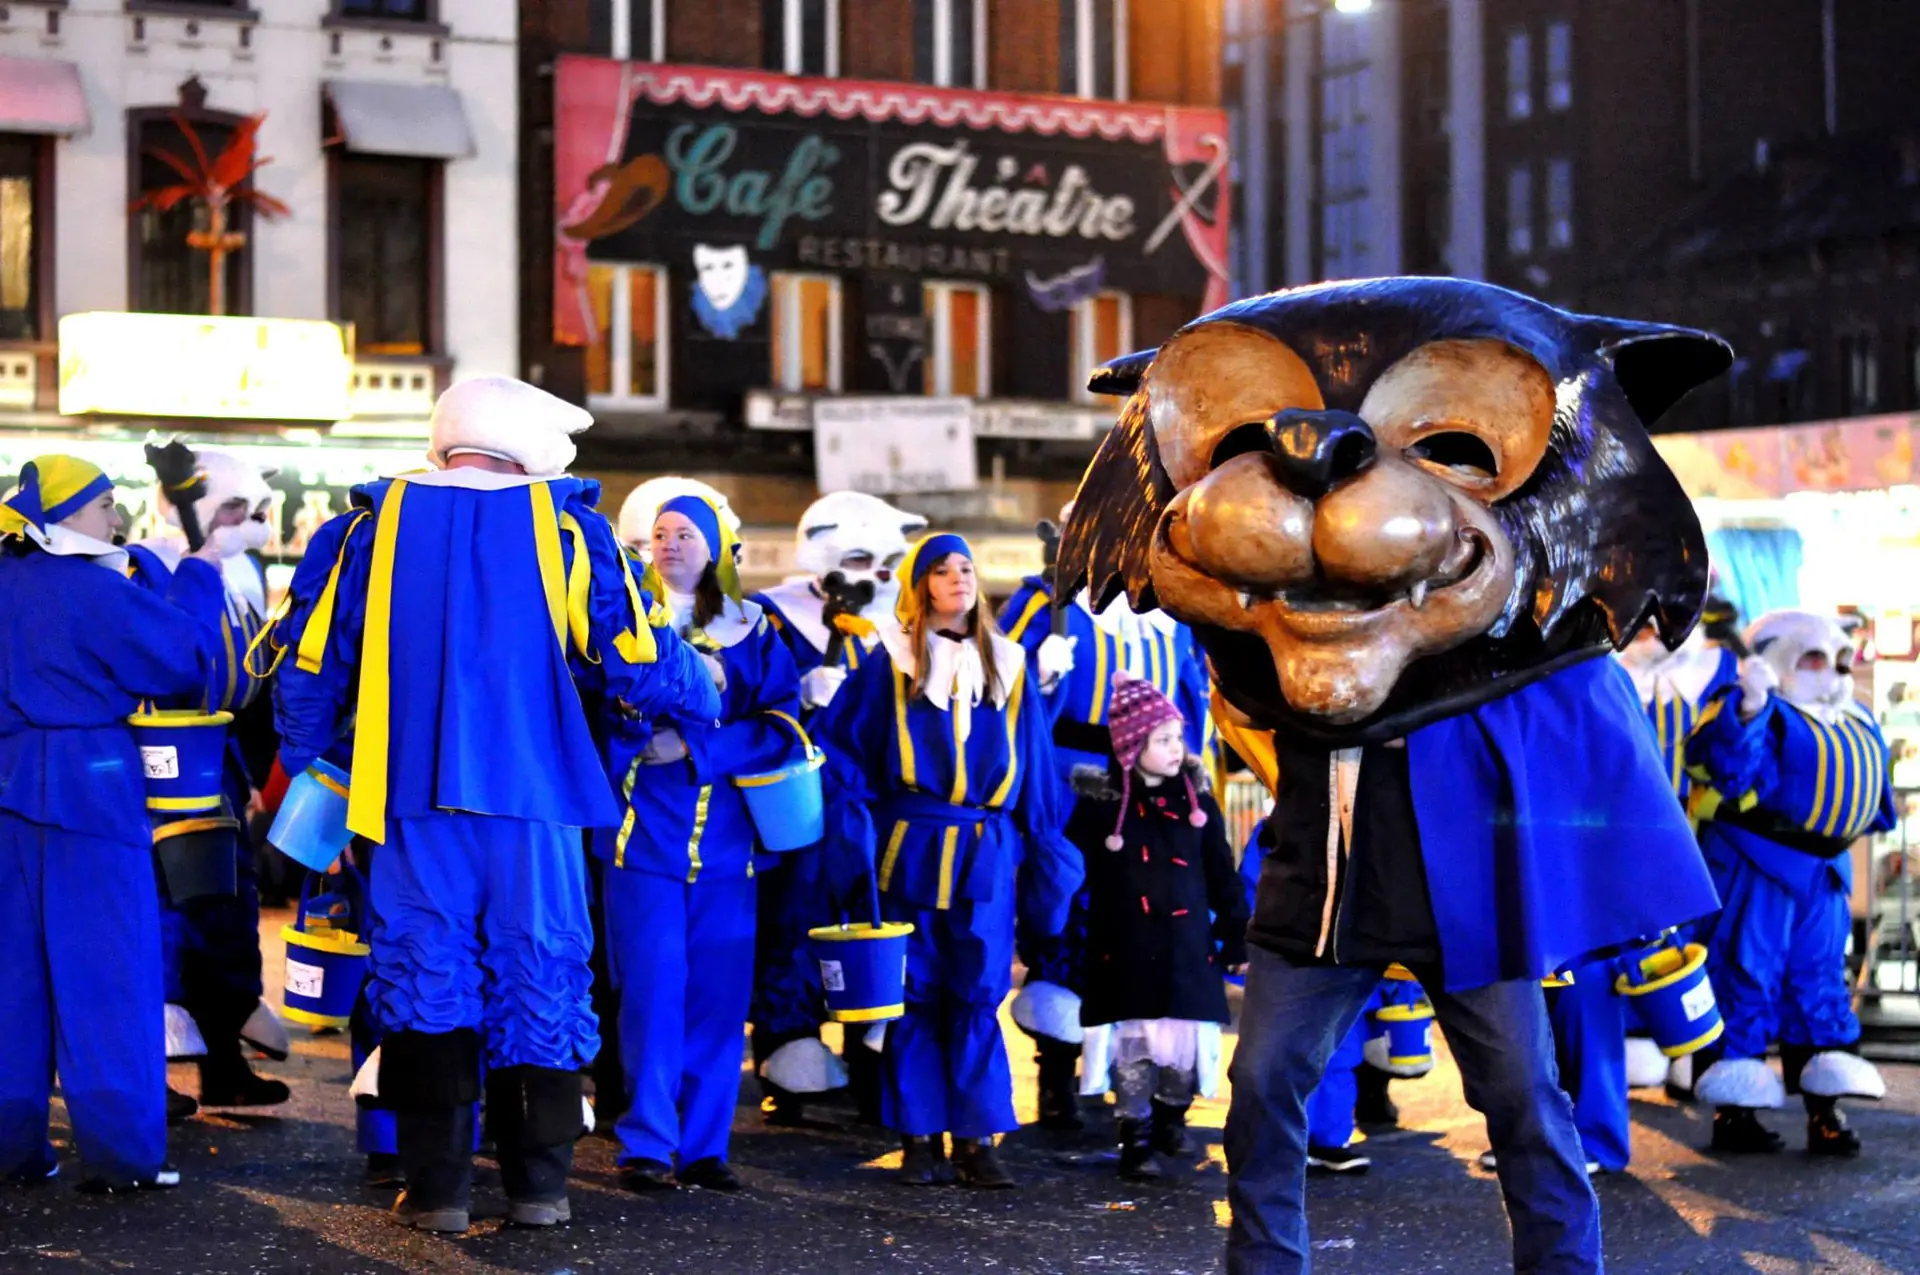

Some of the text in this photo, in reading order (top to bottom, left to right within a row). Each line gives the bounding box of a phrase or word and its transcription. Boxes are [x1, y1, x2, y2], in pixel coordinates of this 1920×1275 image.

[665, 123, 1136, 250] Café Théâtre
[798, 236, 1010, 275] RESTAURANT
